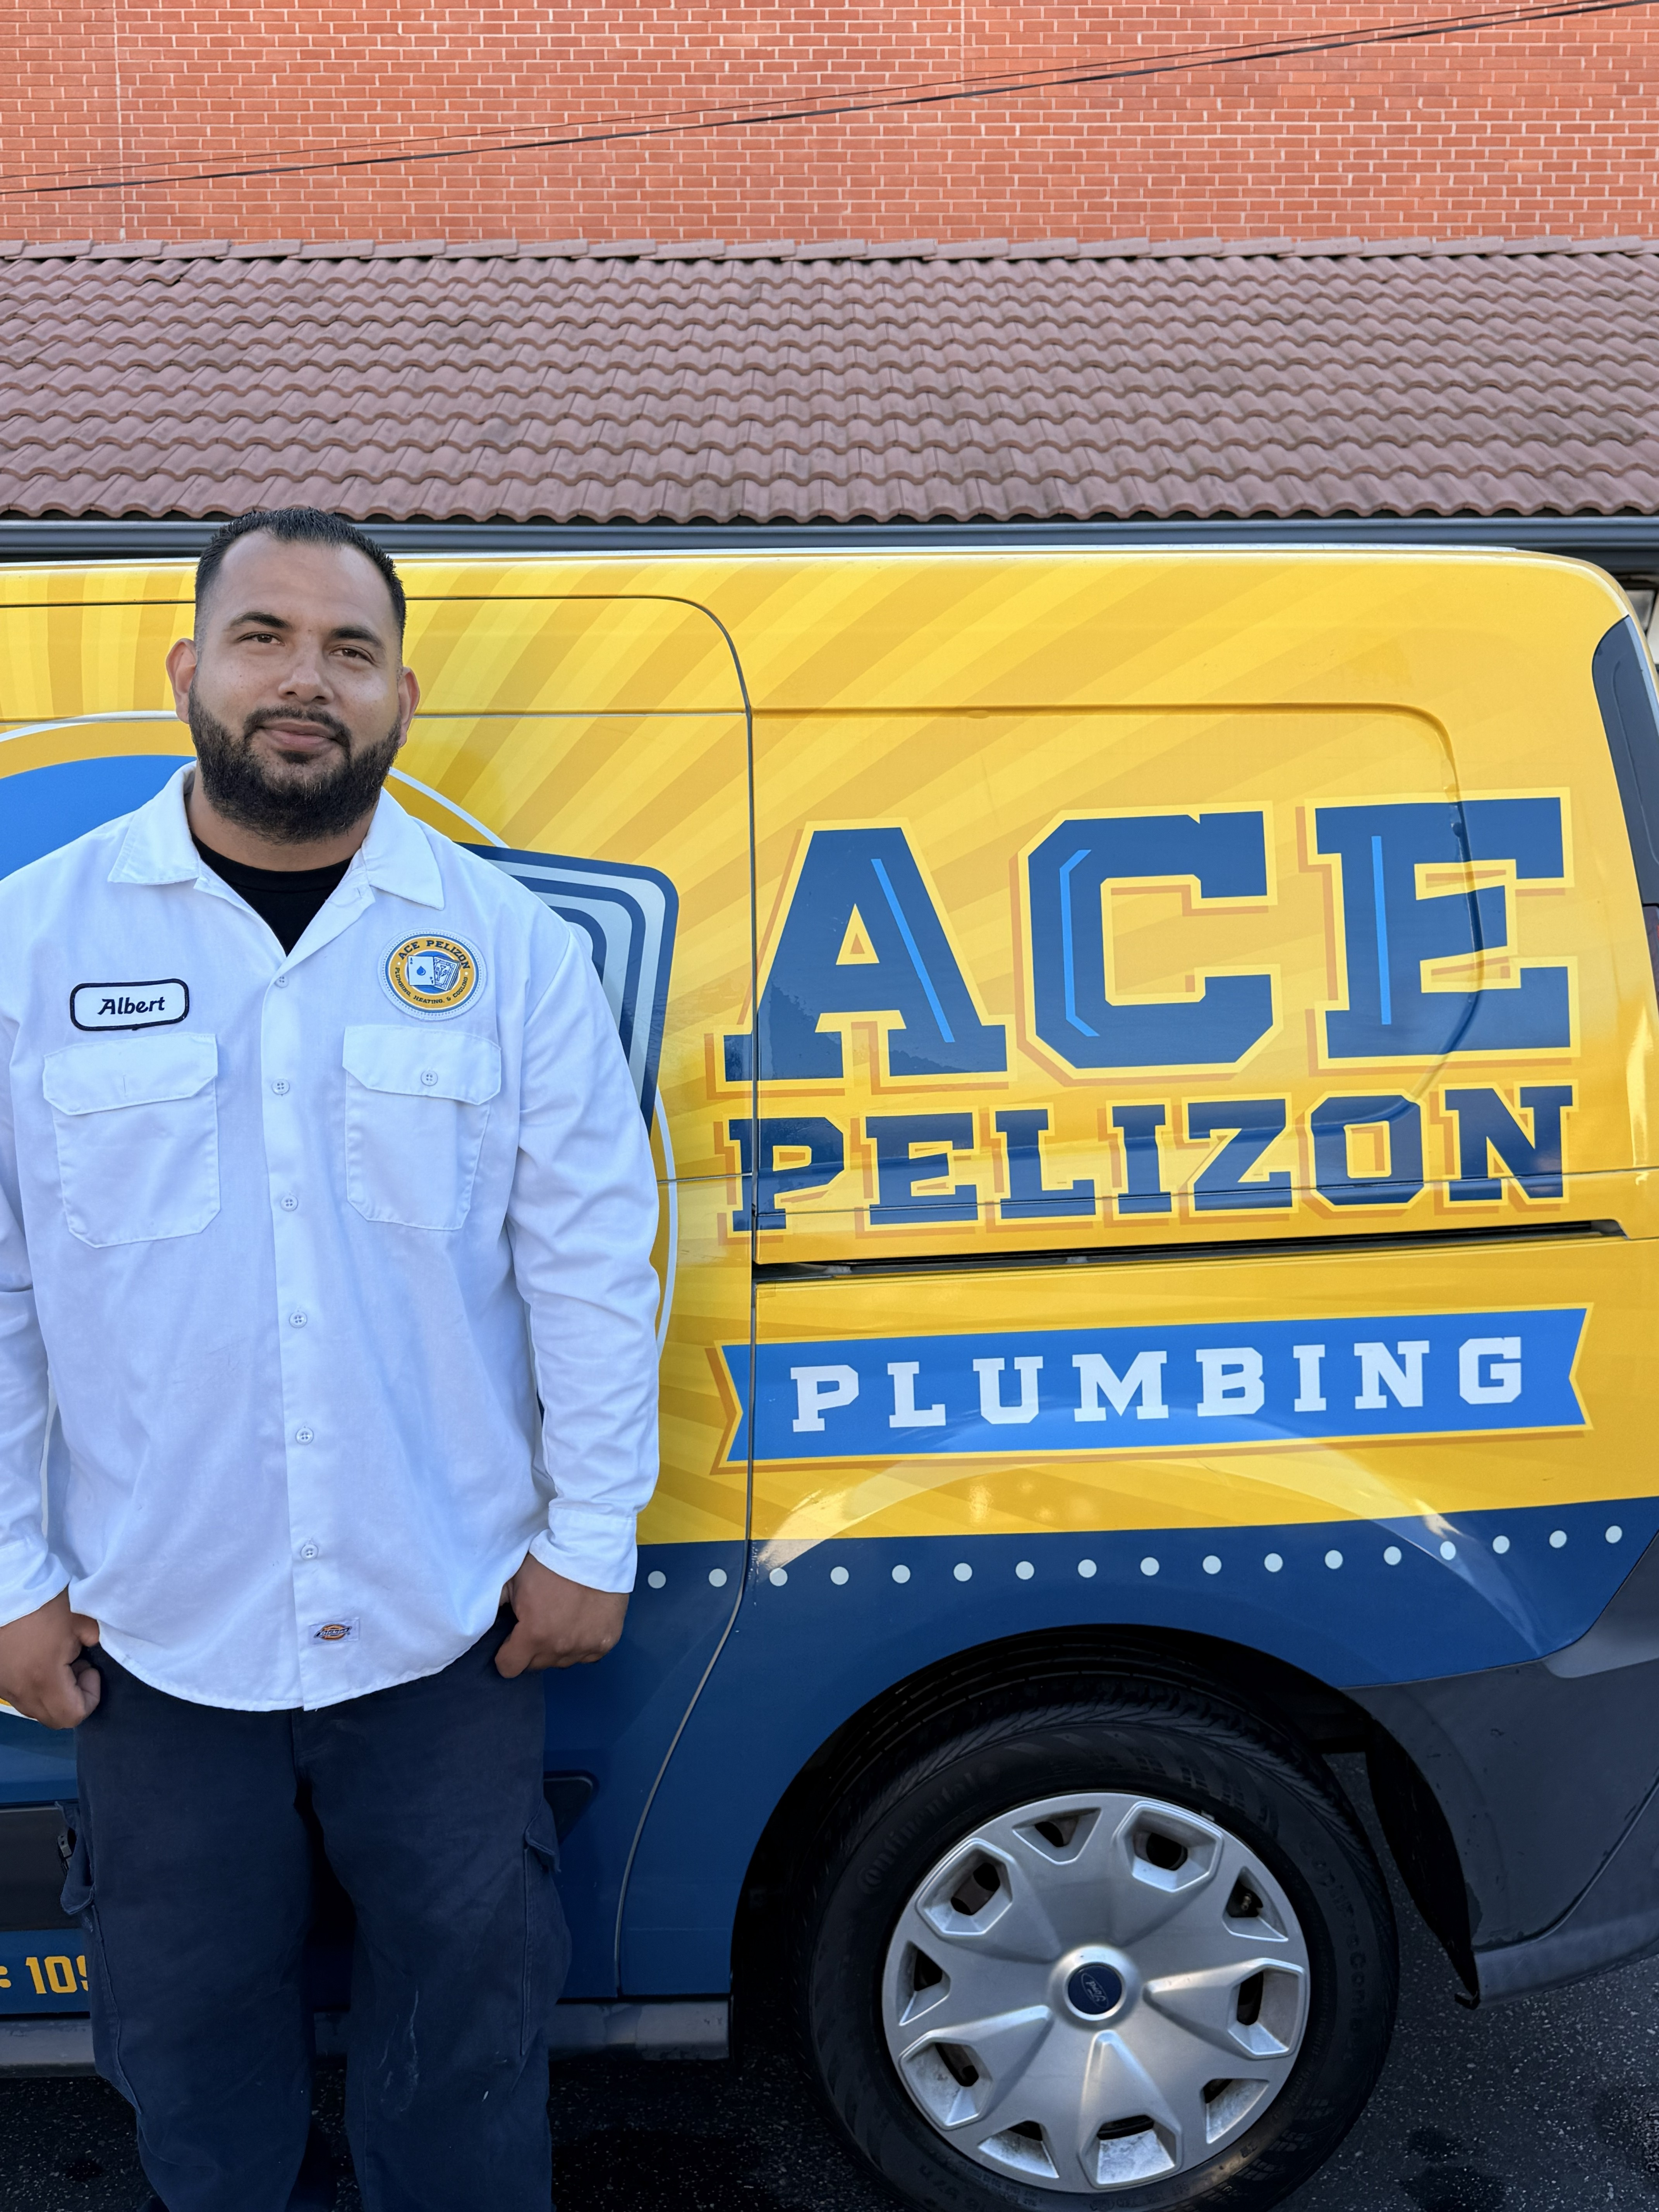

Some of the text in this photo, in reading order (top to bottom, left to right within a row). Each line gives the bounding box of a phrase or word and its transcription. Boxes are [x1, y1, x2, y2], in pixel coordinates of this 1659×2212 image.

[398, 940, 471, 969] ACE PELIZON
[724, 795, 1571, 1082] ACE
[97, 996, 165, 1015] Albert
[728, 1085, 1574, 1232] PELIZON
[790, 1336, 1522, 1433] PLUMBING
[857, 1771, 977, 1894] Continental
